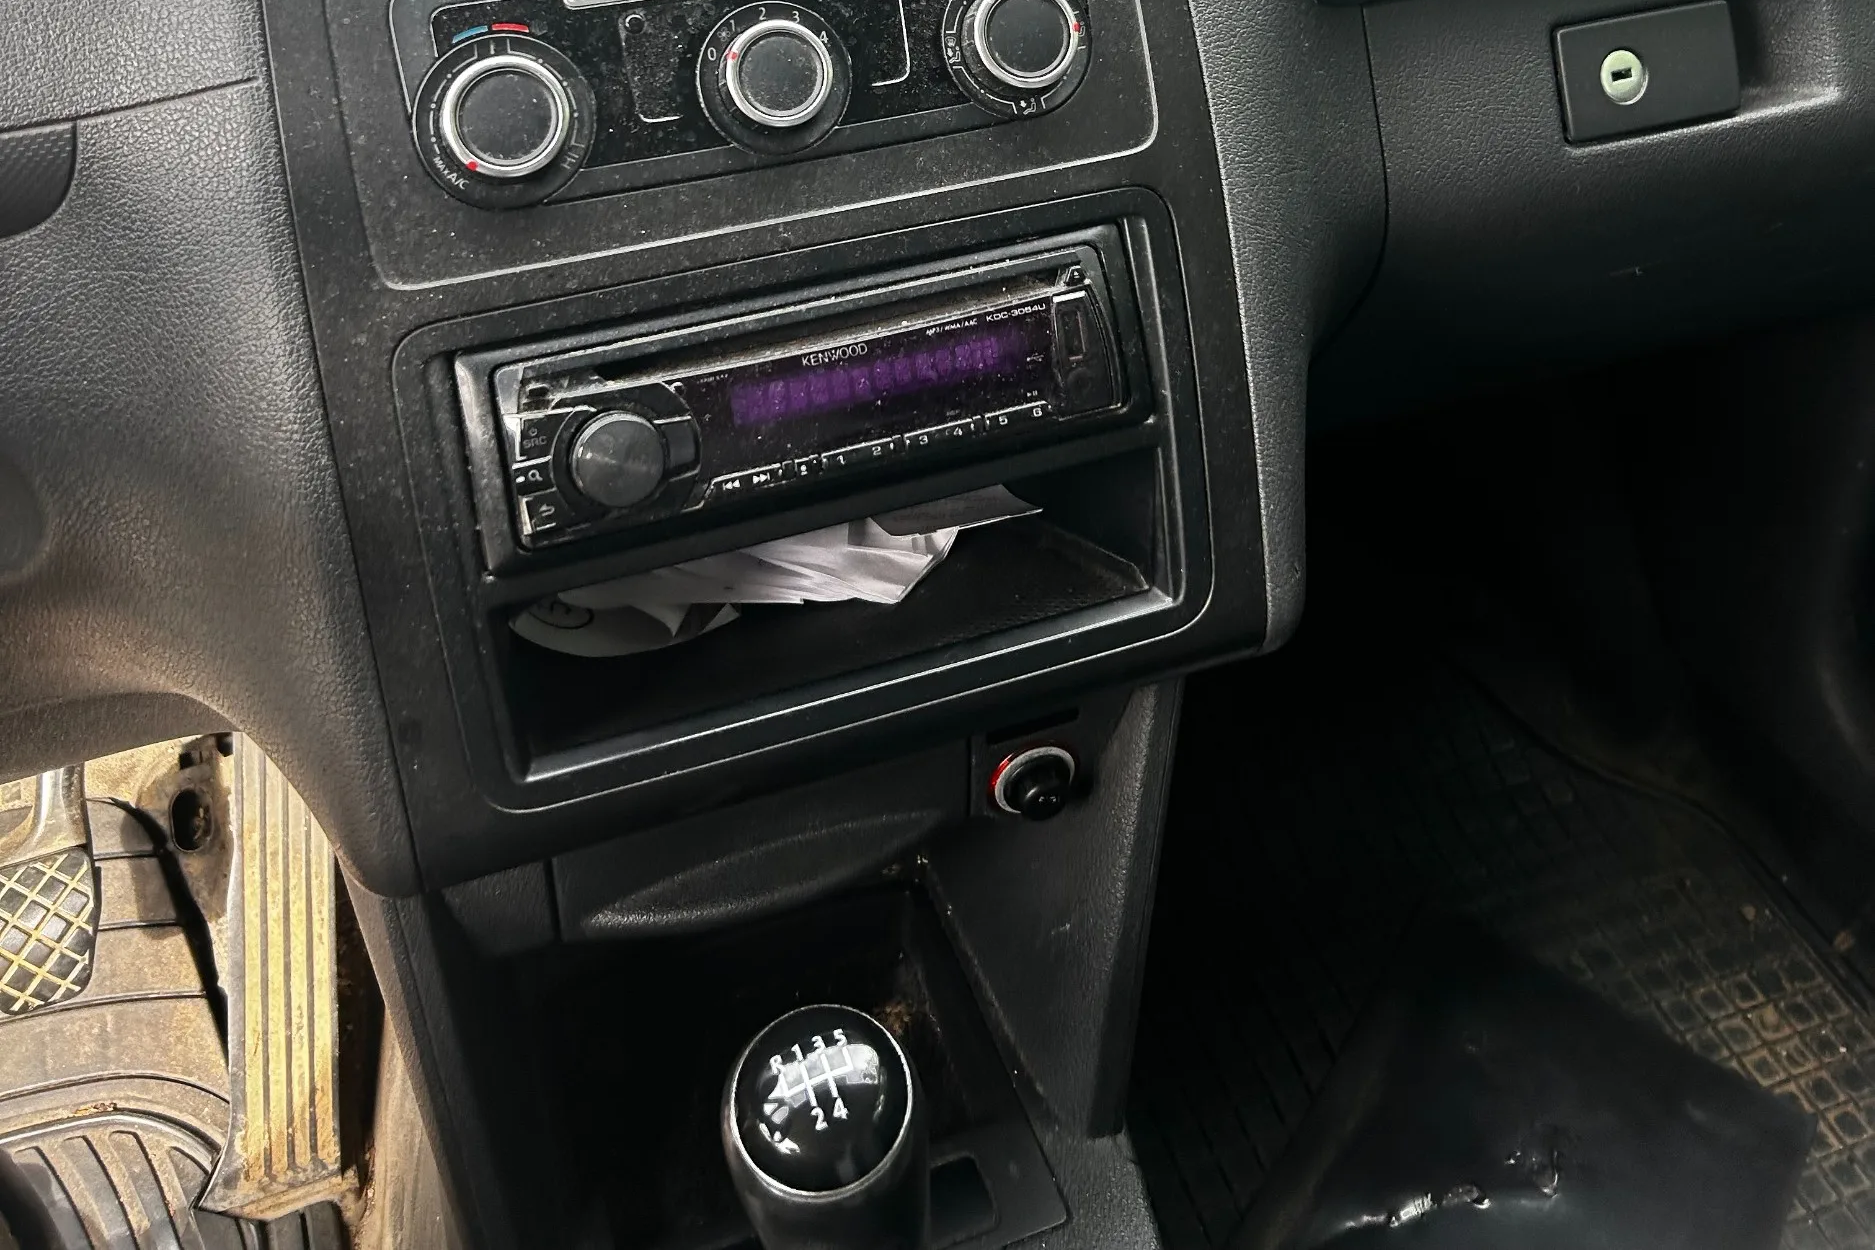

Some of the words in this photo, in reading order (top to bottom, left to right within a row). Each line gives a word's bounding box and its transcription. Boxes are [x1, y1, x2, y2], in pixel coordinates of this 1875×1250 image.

[707, 47, 717, 61] 0
[729, 19, 736, 32] 1
[758, 7, 767, 21] 2
[791, 10, 801, 24] 3
[819, 30, 829, 44] 4
[986, 302, 1046, 322] KDC-3054U
[802, 343, 868, 367] KENWOOD
[872, 445, 882, 456] 2
[918, 435, 928, 445] 3
[999, 415, 1008, 425] 5
[769, 1054, 785, 1075] R
[791, 1043, 803, 1062] 1
[811, 1035, 826, 1050] 3
[833, 1028, 848, 1047] 5
[810, 1106, 828, 1131] 2
[832, 1097, 849, 1119] 4
